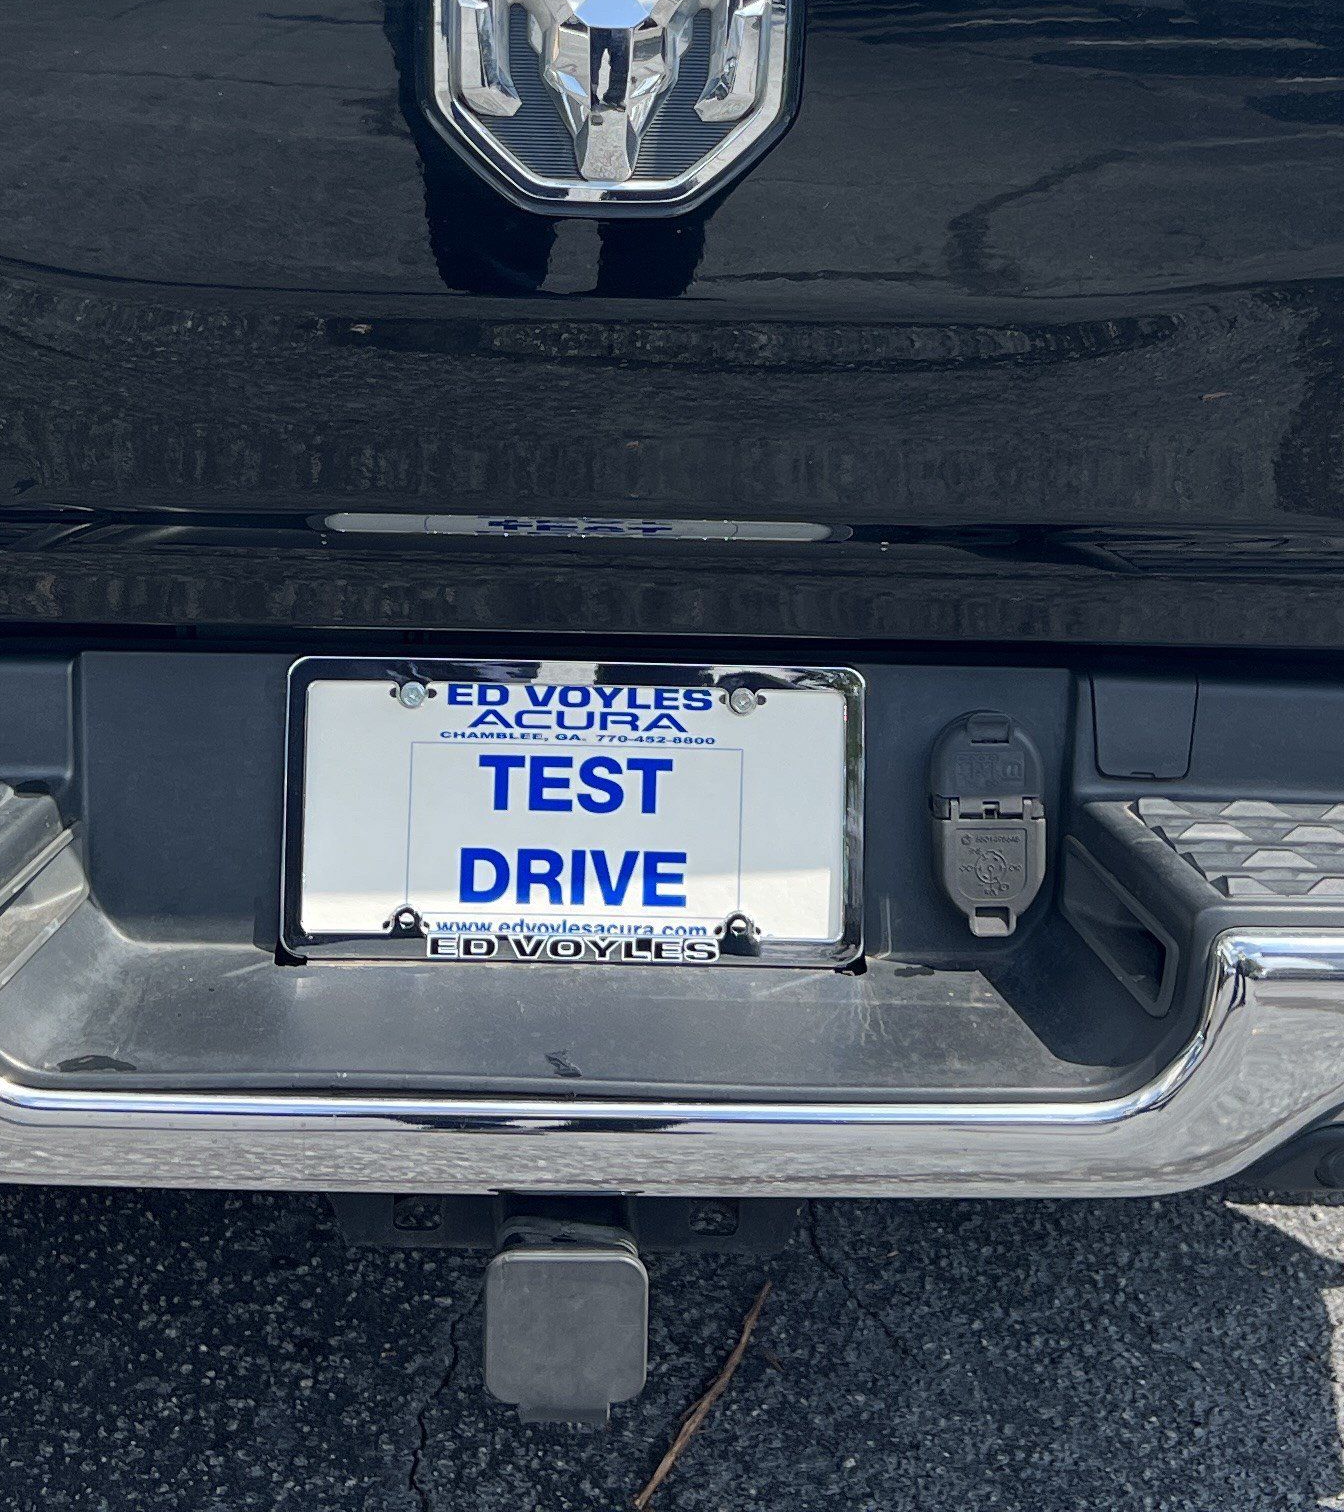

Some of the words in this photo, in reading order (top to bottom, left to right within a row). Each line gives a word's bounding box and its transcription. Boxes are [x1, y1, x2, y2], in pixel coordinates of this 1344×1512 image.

[447, 683, 509, 706] ED
[524, 685, 714, 712] VOYLES
[467, 708, 689, 733] ACURA
[440, 731, 549, 742] CHAMBLEE,
[478, 754, 674, 815] TEST
[459, 847, 688, 908] DRIVE
[436, 918, 707, 936] wwwedvoylesacuracom
[426, 933, 499, 958] ED
[507, 935, 720, 963] VOYLES
